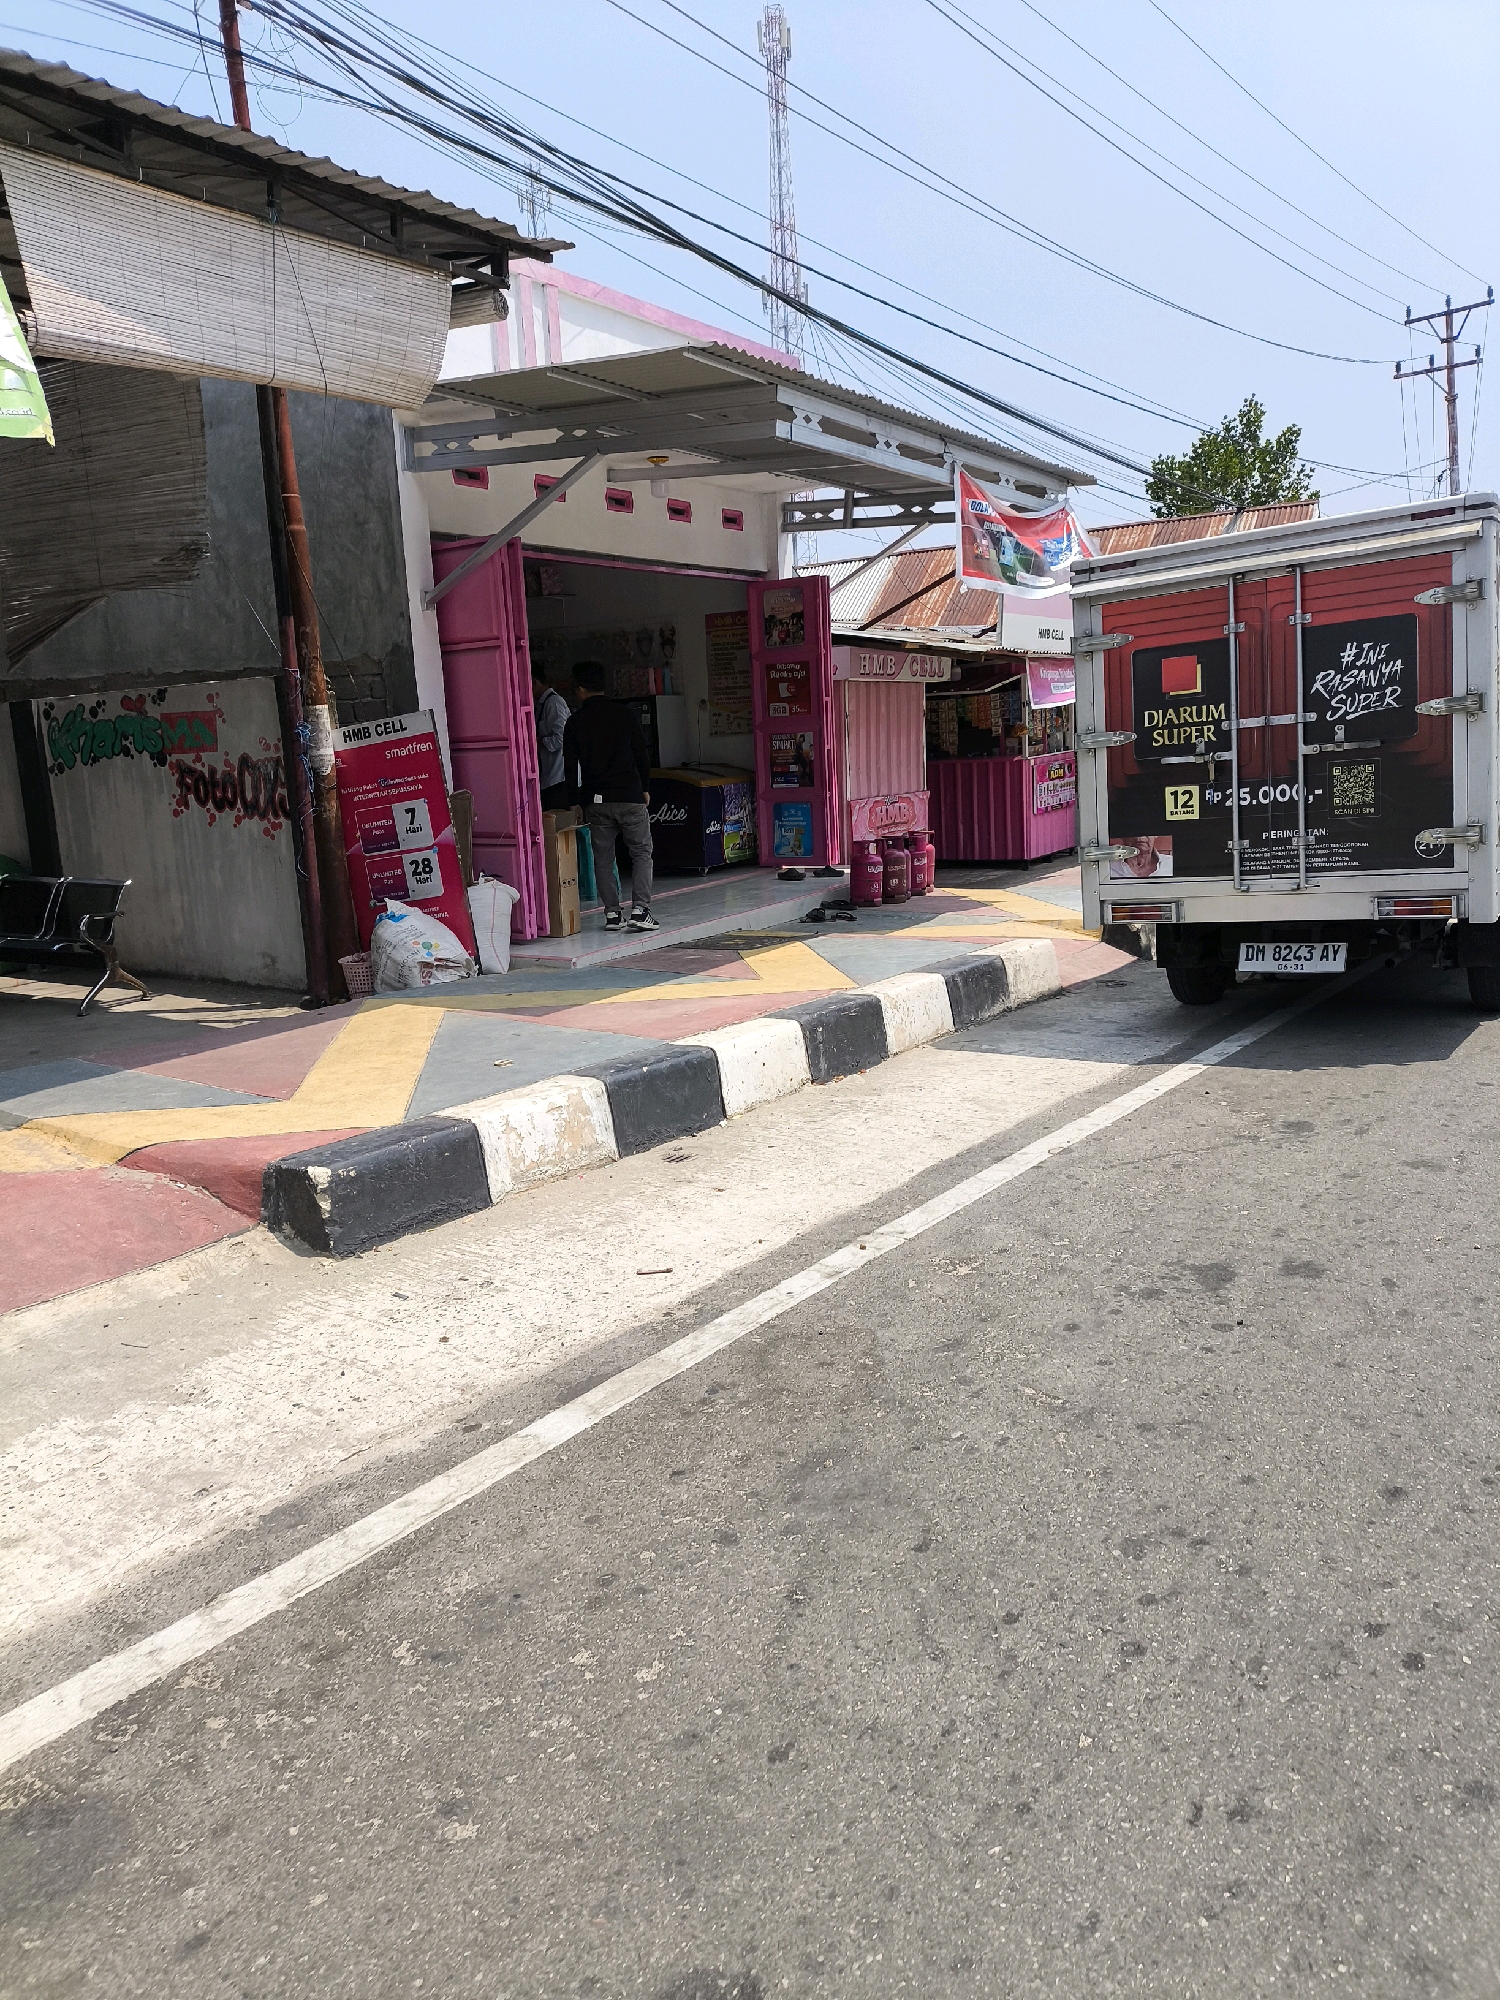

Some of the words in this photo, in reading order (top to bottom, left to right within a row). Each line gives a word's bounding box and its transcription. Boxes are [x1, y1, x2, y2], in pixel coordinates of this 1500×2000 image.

[1051, 629, 1064, 640] CELL
[860, 653, 896, 677] HMB
[909, 655, 944, 678] CELL
[1340, 641, 1390, 670] #INI
[1310, 659, 1405, 700] RASANYA
[1325, 686, 1402, 721] SUPER
[1144, 703, 1226, 728] DJARUM
[342, 727, 372, 744] HMB
[374, 719, 408, 738] CELL
[1152, 724, 1217, 747] SUPER
[385, 741, 433, 760] smartfren
[1170, 789, 1194, 810] 12
[404, 808, 416, 826] 7
[649, 803, 688, 823] Aice
[875, 802, 909, 827] HMB
[405, 824, 423, 835] Hari
[1262, 827, 1330, 840] PERINGTAN:
[409, 857, 434, 877] 28
[415, 875, 432, 885] Hari
[1244, 944, 1266, 962] DM
[1319, 944, 1342, 962] AY
[1277, 963, 1305, 971] 06-31
